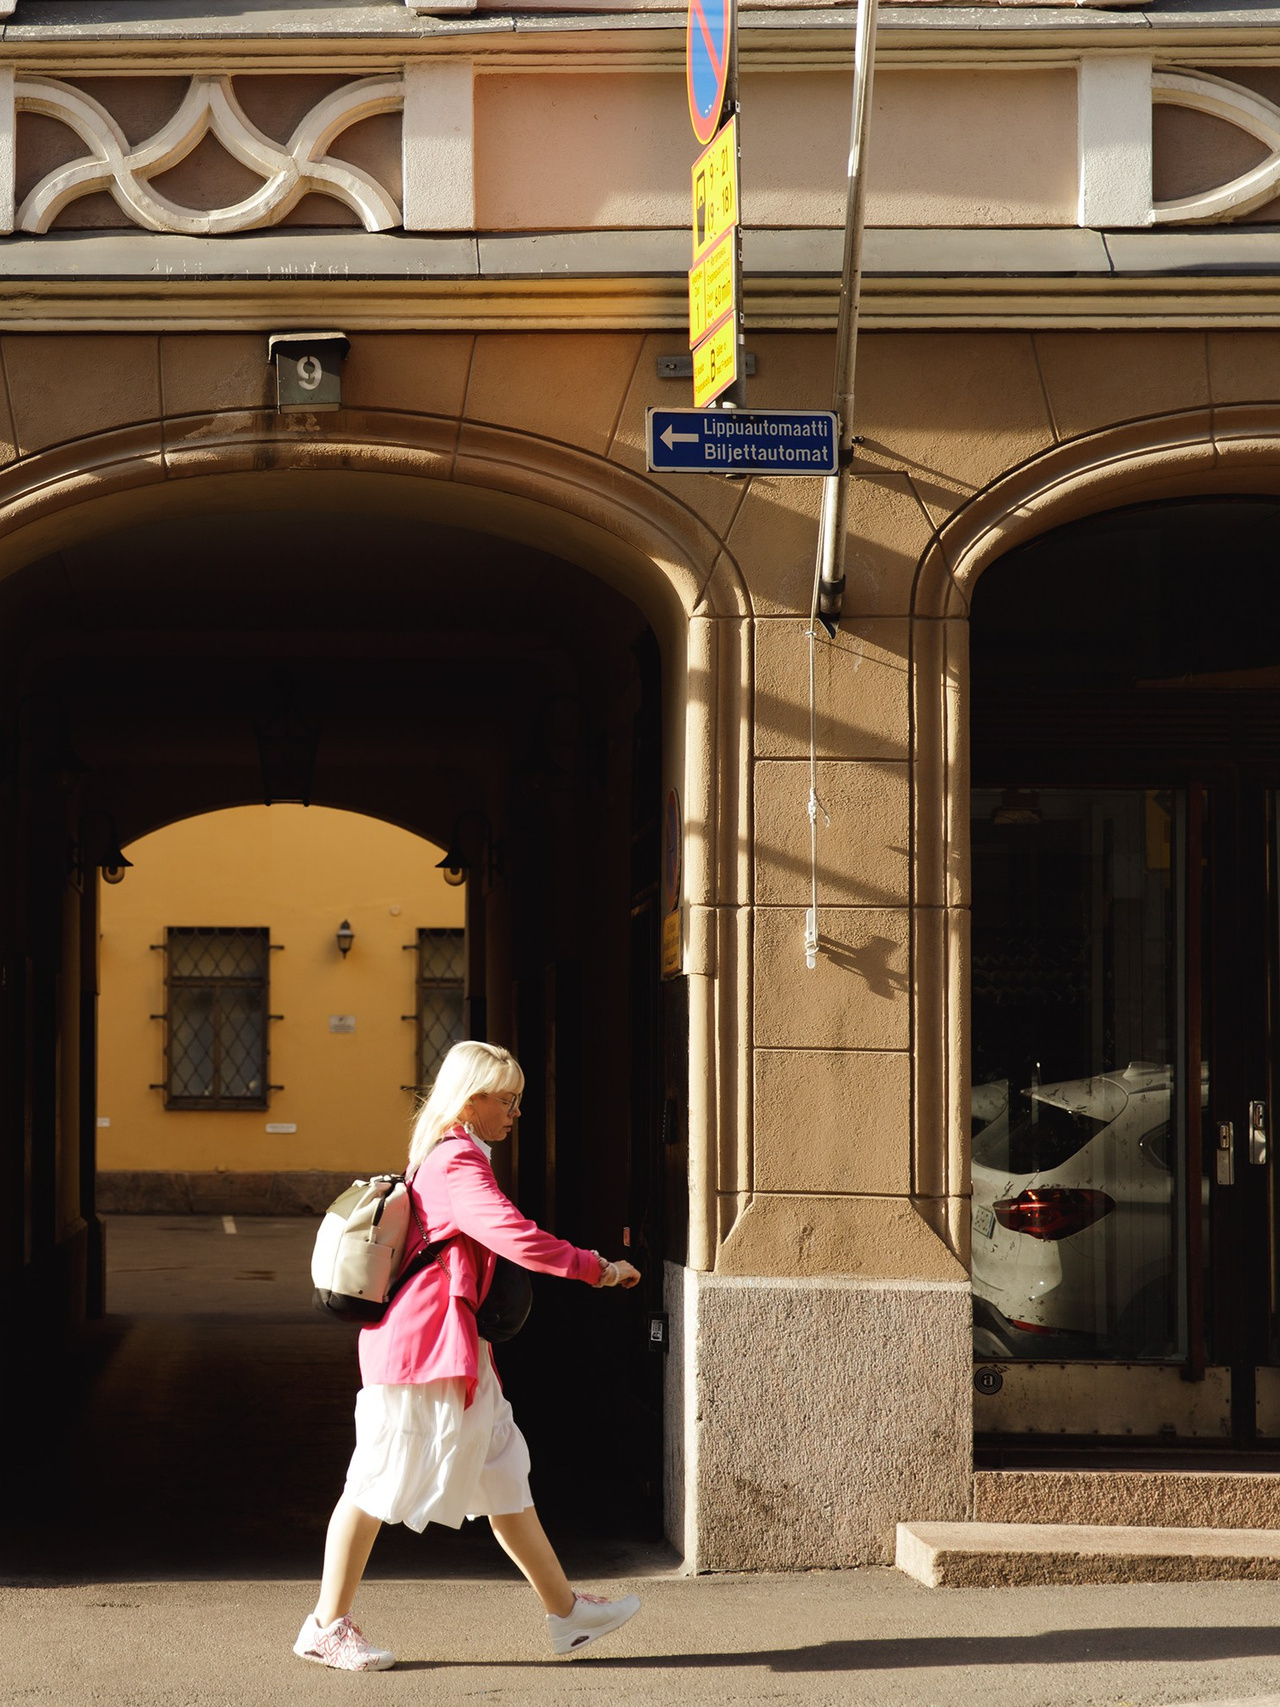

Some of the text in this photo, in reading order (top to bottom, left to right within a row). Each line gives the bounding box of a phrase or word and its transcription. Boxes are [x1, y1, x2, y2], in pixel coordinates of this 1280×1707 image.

[709, 163, 714, 190] 9
[721, 145, 729, 176] 21
[296, 355, 323, 391] 9
[703, 417, 828, 442] Lippuautomaatti
[704, 443, 829, 464] Biljettautomat
